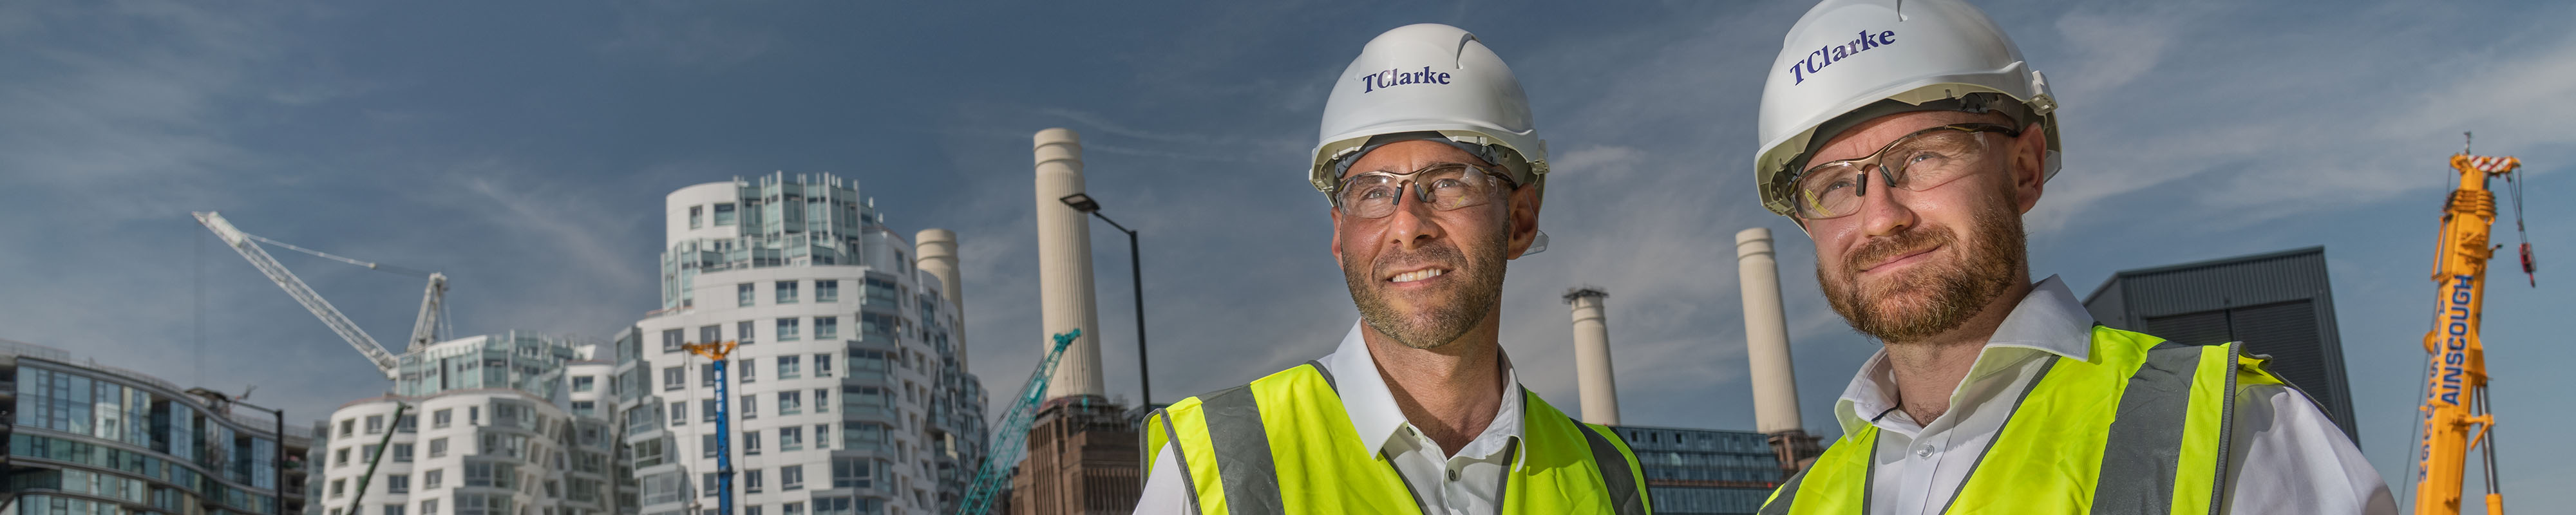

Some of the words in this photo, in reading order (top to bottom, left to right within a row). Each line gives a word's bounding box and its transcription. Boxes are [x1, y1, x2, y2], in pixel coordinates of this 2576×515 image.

[1362, 66, 1451, 93] TClarke
[1790, 30, 1896, 86] TClarke
[2441, 274, 2474, 406] AINSCOUGH
[2418, 299, 2445, 482] AINSCOUGH
